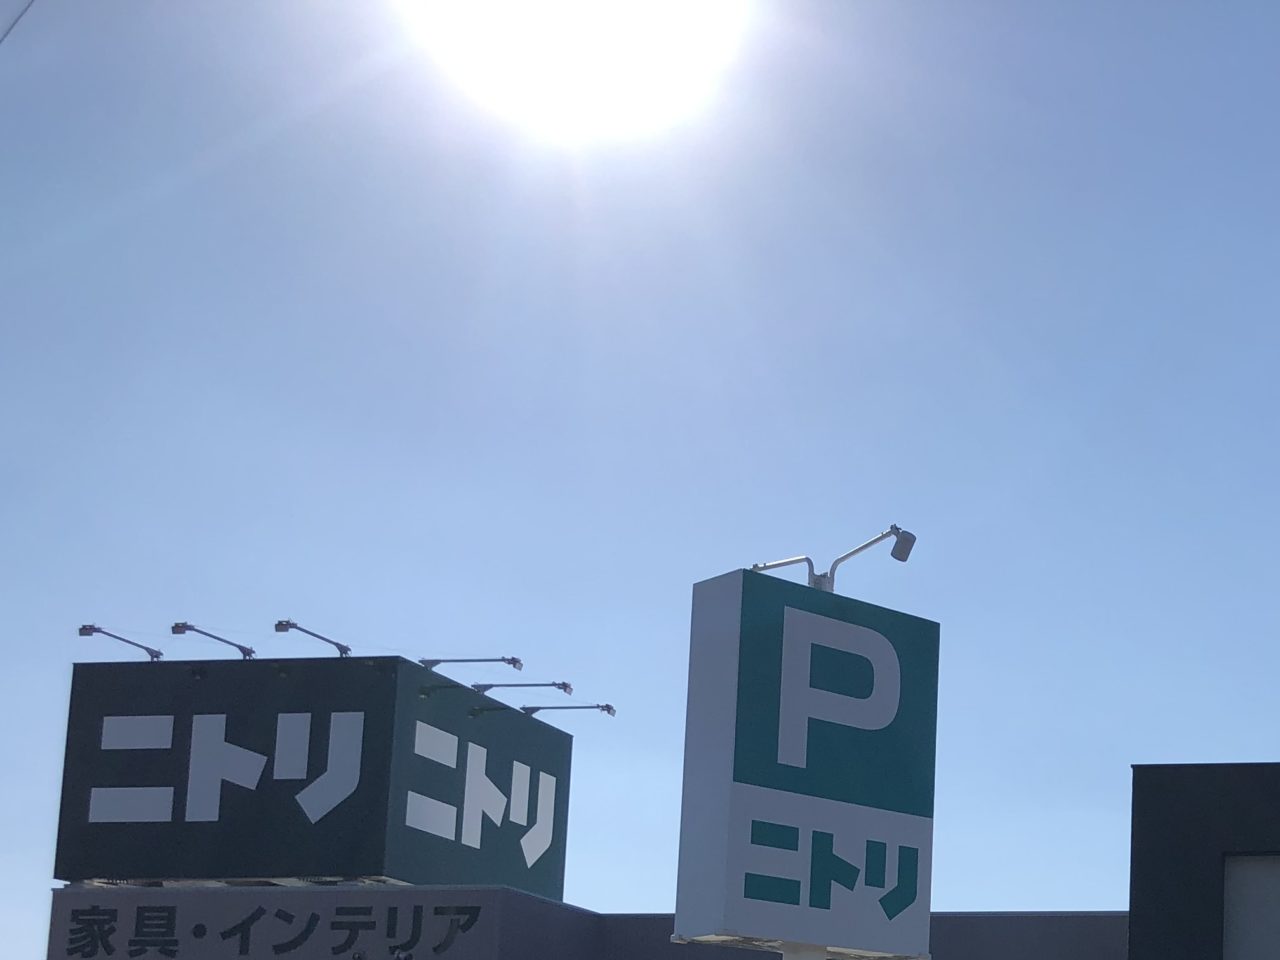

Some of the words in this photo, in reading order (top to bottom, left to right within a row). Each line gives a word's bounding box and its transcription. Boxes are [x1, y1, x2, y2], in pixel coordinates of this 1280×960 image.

[777, 605, 901, 769] P
[88, 711, 365, 824] ニトリ
[404, 720, 557, 869] ニトリ
[743, 818, 919, 921] ニトリ
[66, 904, 482, 959] 家具・インテリア
